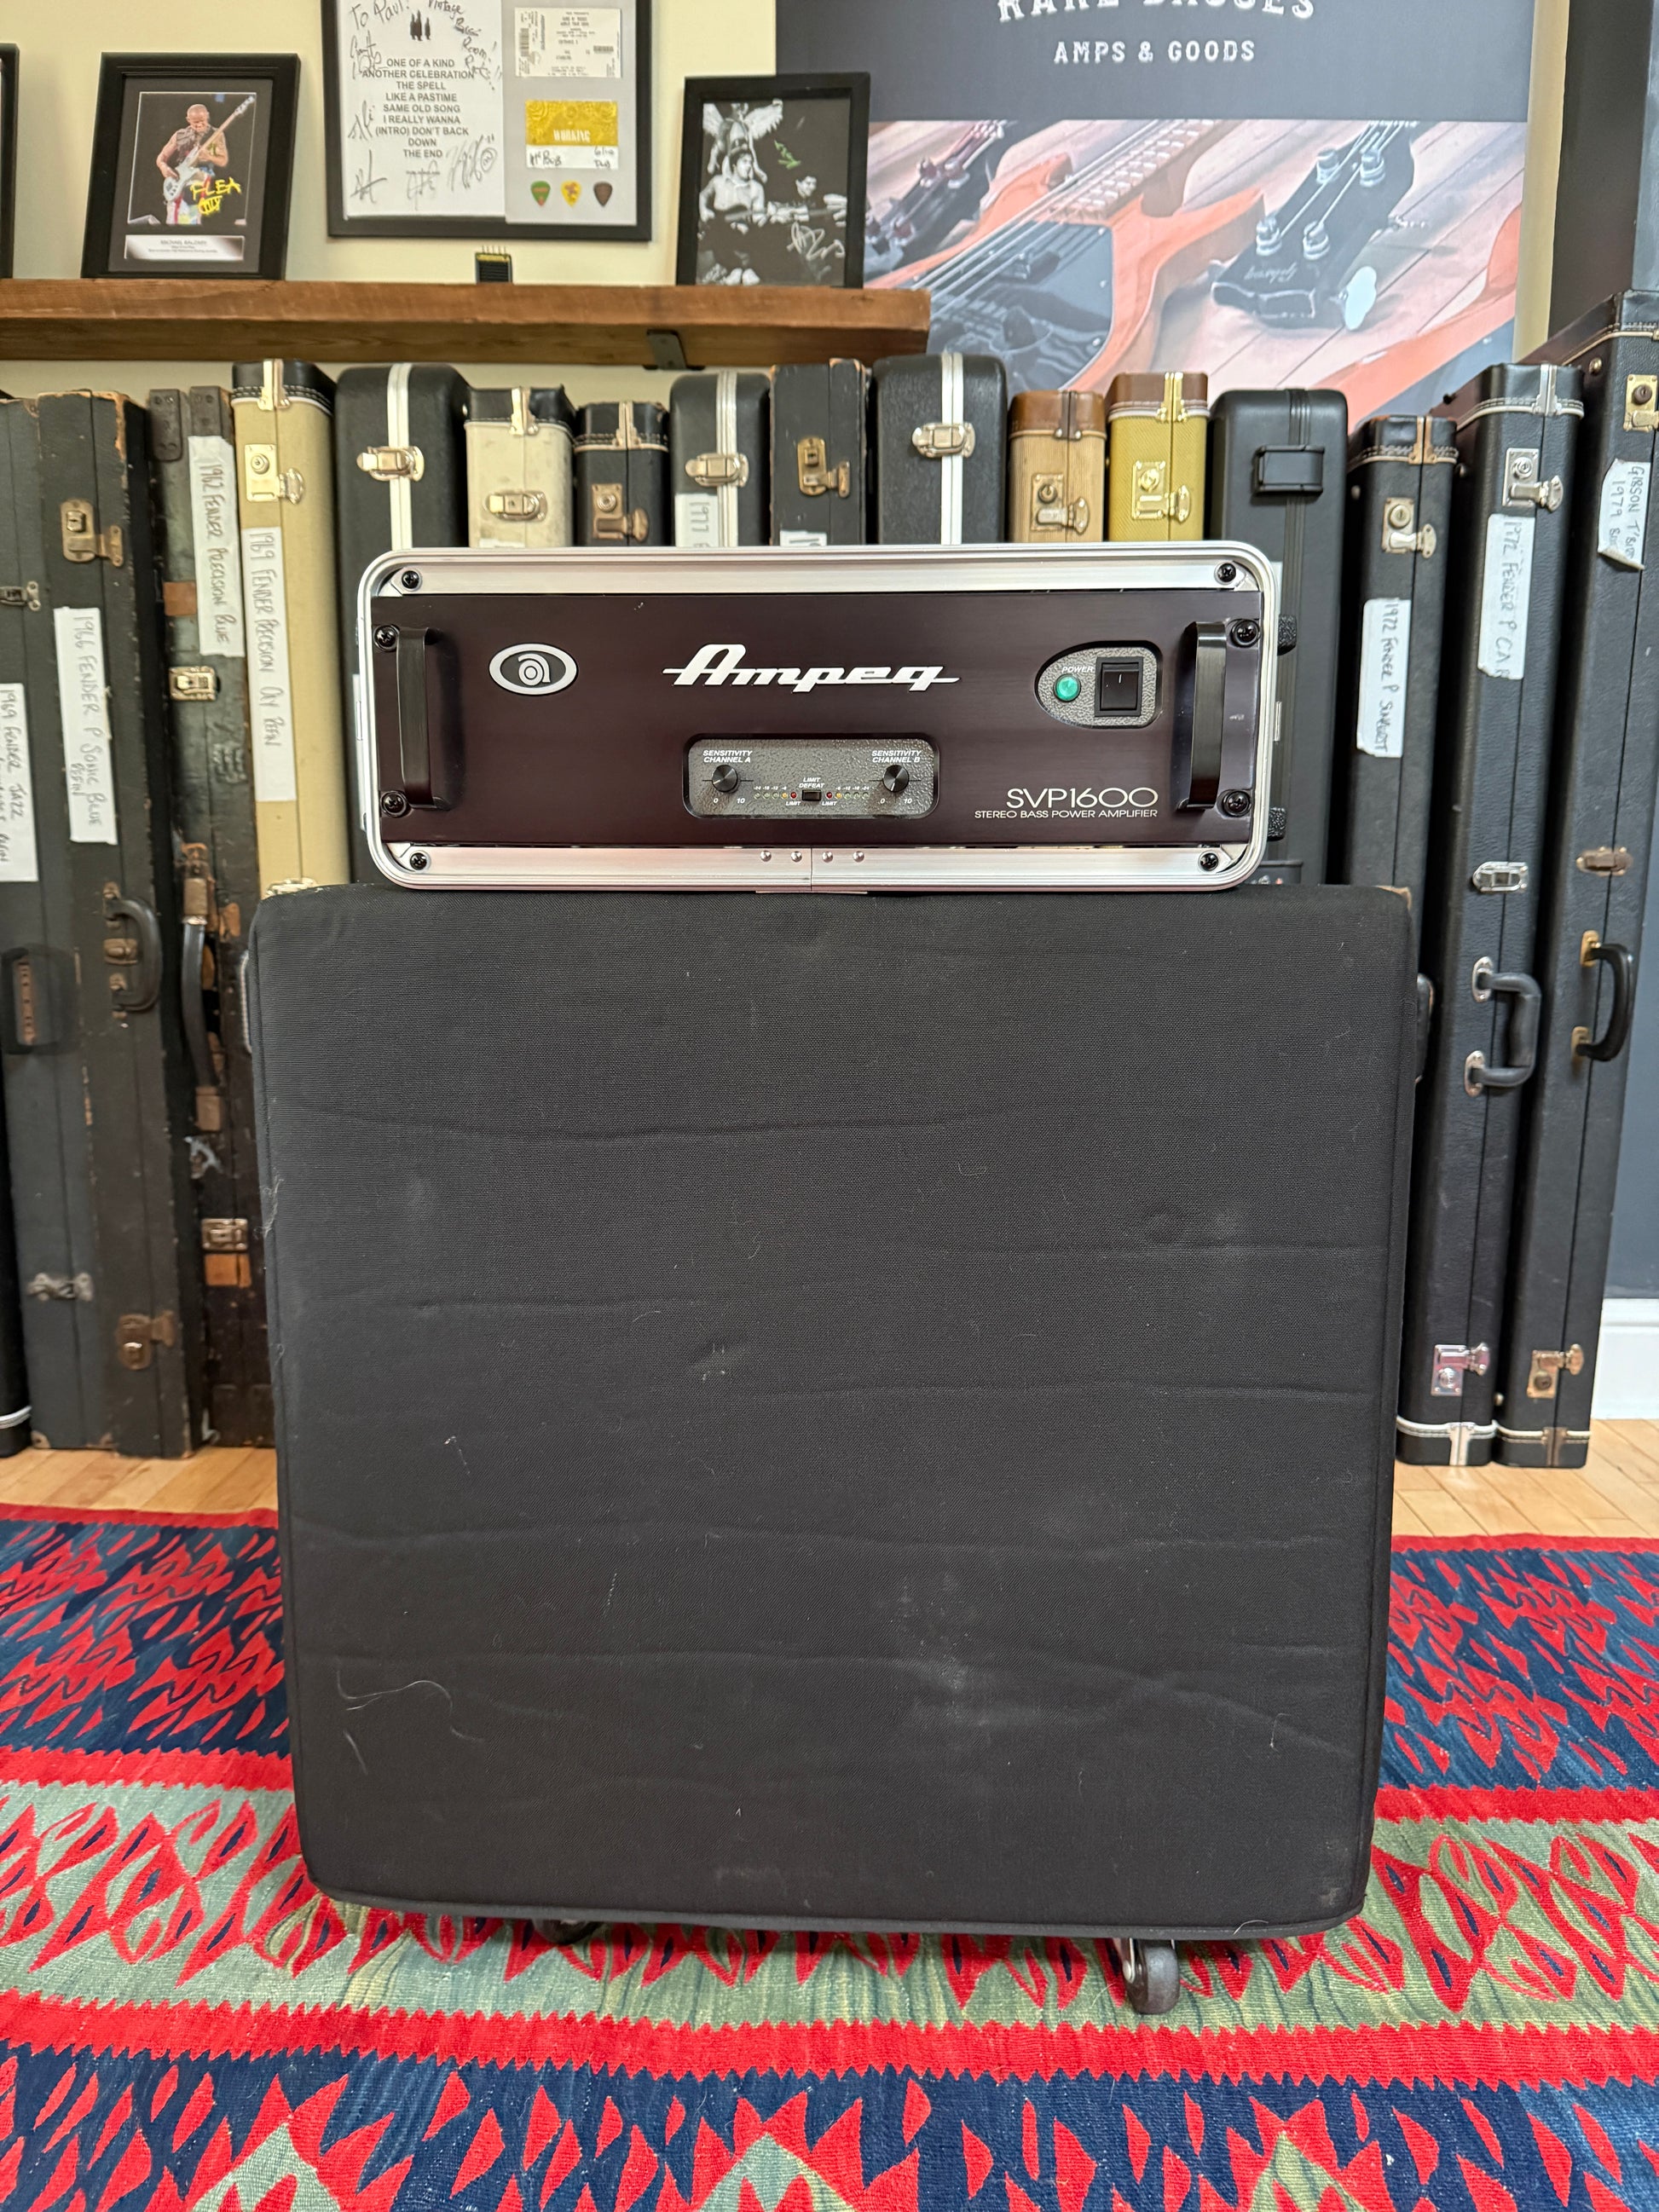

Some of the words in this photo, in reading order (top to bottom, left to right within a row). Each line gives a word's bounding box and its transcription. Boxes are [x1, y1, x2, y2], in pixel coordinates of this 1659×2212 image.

[1054, 41, 1125, 63] AMPS
[1138, 41, 1153, 62] &
[1168, 40, 1255, 62] GOODS
[386, 59, 407, 67] ONE
[409, 59, 421, 67] OF
[423, 59, 431, 67] A
[432, 59, 455, 67] KIND
[362, 70, 407, 78] ANOTHER
[409, 70, 474, 78] CELEBRATION
[396, 82, 414, 90] THE
[417, 82, 446, 90] SPELL
[385, 93, 407, 101] LIKE
[408, 93, 417, 101] A
[418, 93, 457, 102] PASTIME
[384, 104, 409, 113] SAME
[412, 104, 431, 113] OLD
[433, 104, 460, 113] SONG
[388, 115, 425, 124] REALLY
[425, 115, 461, 124] WANNA
[375, 126, 409, 136] (INTRO)
[412, 127, 441, 136] DON'T
[442, 127, 470, 136] BACK
[408, 138, 436, 147] DOWN
[403, 149, 422, 158] THE
[424, 149, 442, 158] END
[190, 177, 241, 200] FLEA
[199, 463, 223, 493] 1962
[1627, 465, 1645, 513] GIBSON
[206, 546, 229, 606] PRECISION
[1381, 603, 1399, 633] 1972
[73, 615, 95, 649] 1966
[662, 644, 960, 692] Ampeg
[78, 655, 100, 715] FENDER
[1383, 684, 1400, 694] P
[84, 726, 103, 737] P
[1006, 787, 1159, 809] SVP1600
[974, 810, 1018, 818] STEREO
[1020, 810, 1049, 818] BASS
[1051, 810, 1095, 818] POWER
[1098, 810, 1159, 818] AMPLIFIER
